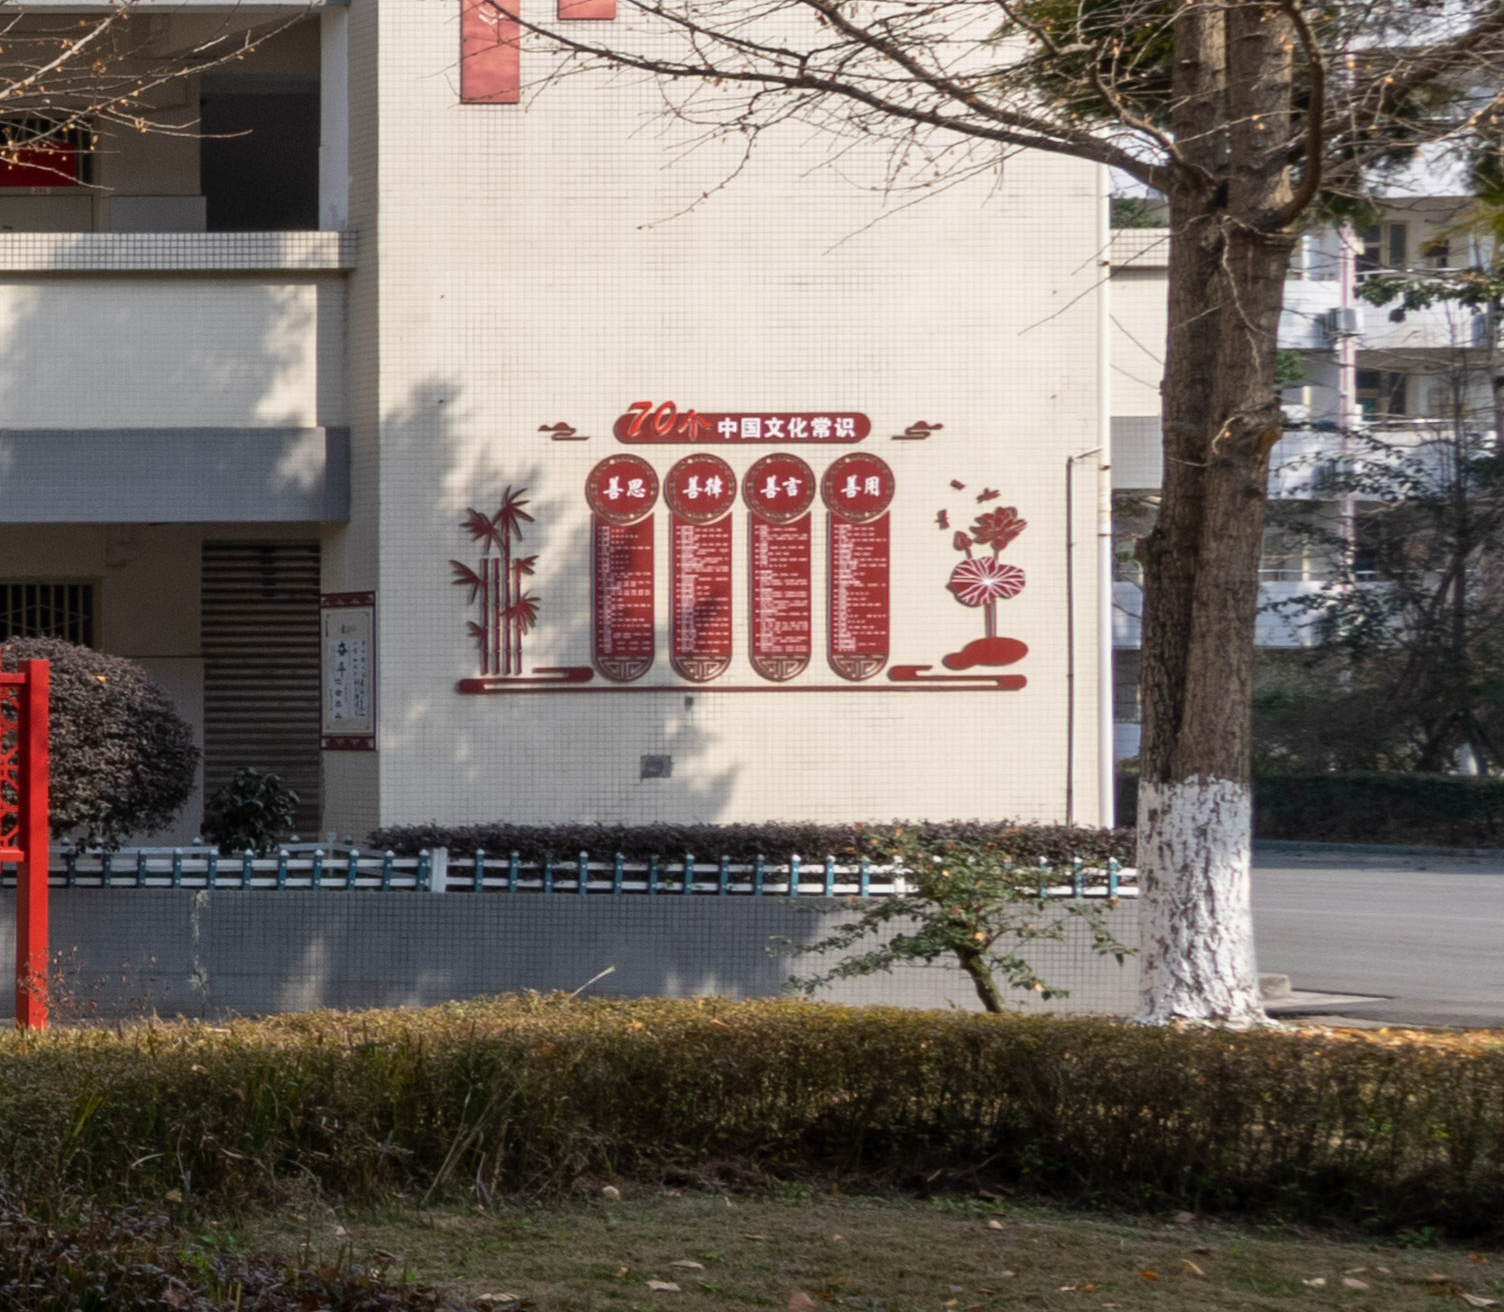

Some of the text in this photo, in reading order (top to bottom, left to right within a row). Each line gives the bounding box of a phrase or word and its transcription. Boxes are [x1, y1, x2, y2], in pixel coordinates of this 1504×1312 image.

[603, 476, 646, 499] 善思
[682, 475, 723, 499] 善律
[760, 475, 802, 499] 善言
[841, 475, 880, 498] 善用
